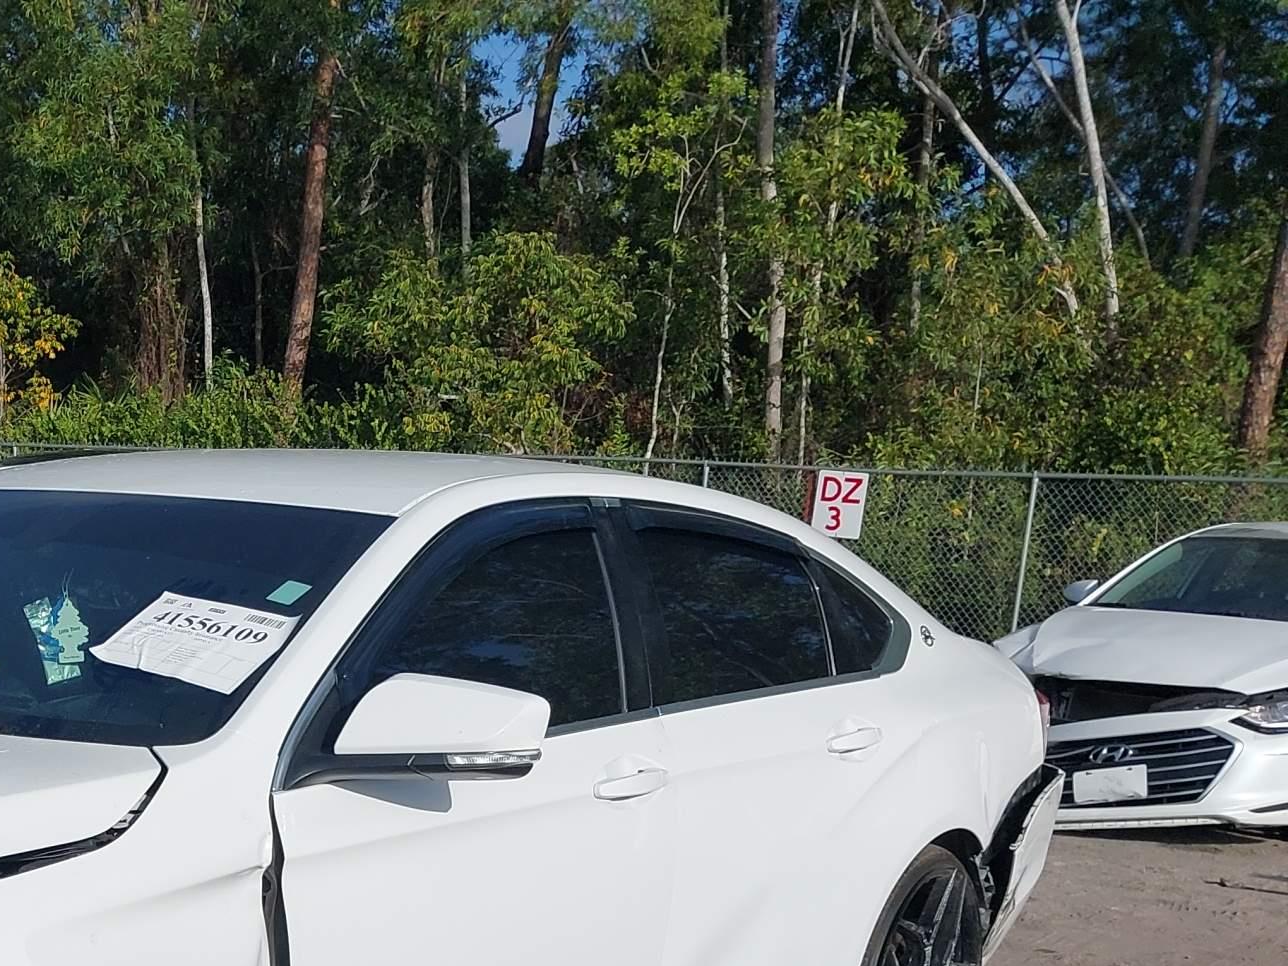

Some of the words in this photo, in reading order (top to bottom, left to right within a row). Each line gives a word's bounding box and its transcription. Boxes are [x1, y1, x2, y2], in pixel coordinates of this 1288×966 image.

[820, 476, 864, 504] DZ
[825, 506, 841, 531] 3
[153, 610, 270, 645] 41556109
